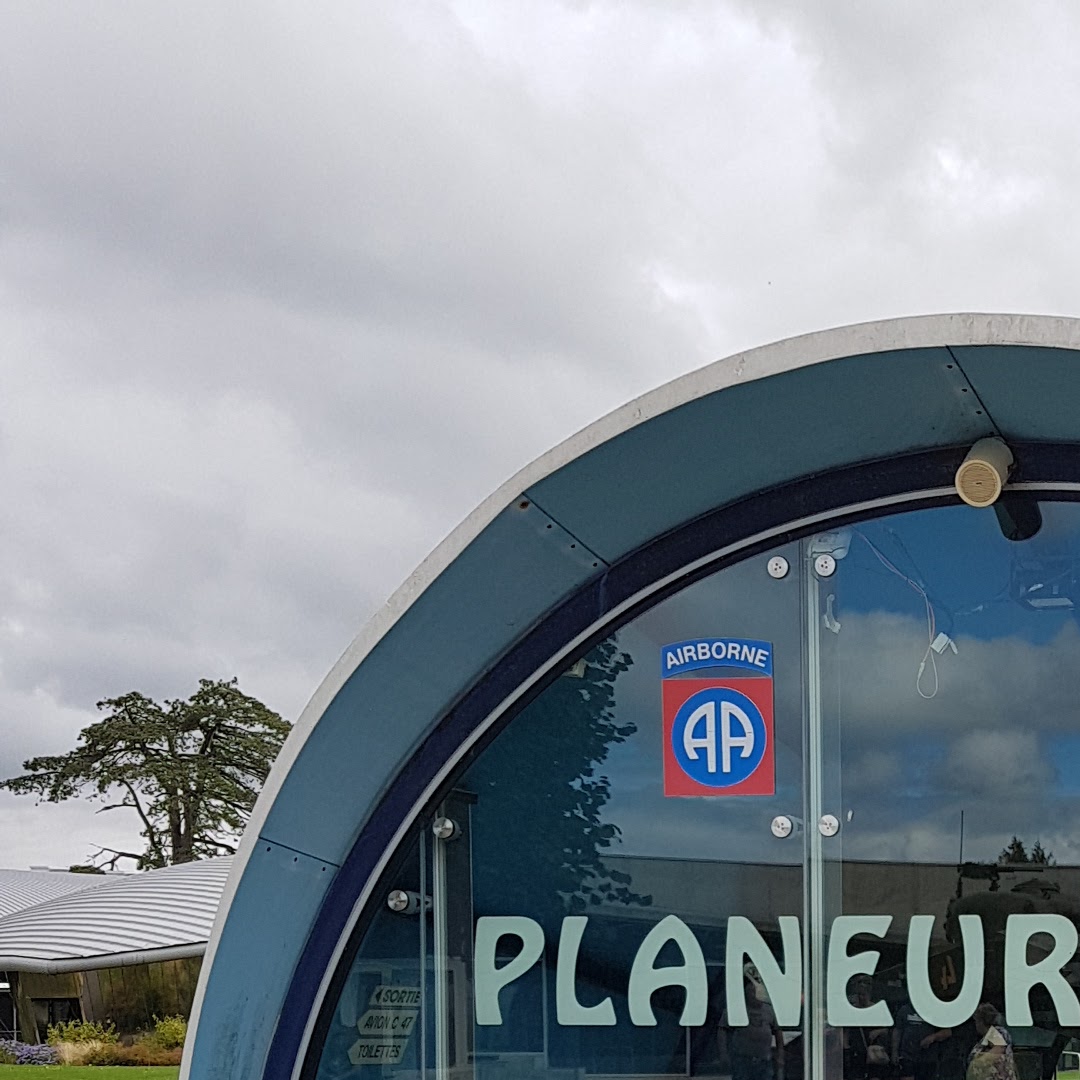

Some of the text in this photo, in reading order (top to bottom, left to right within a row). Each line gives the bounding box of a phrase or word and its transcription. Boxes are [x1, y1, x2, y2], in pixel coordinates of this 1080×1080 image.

[666, 642, 769, 670] AIRBORNE
[683, 701, 755, 773] AA
[382, 989, 421, 1004] SORTIE
[364, 1016, 413, 1030] AVION C 47
[358, 1044, 401, 1059] TOILETTES
